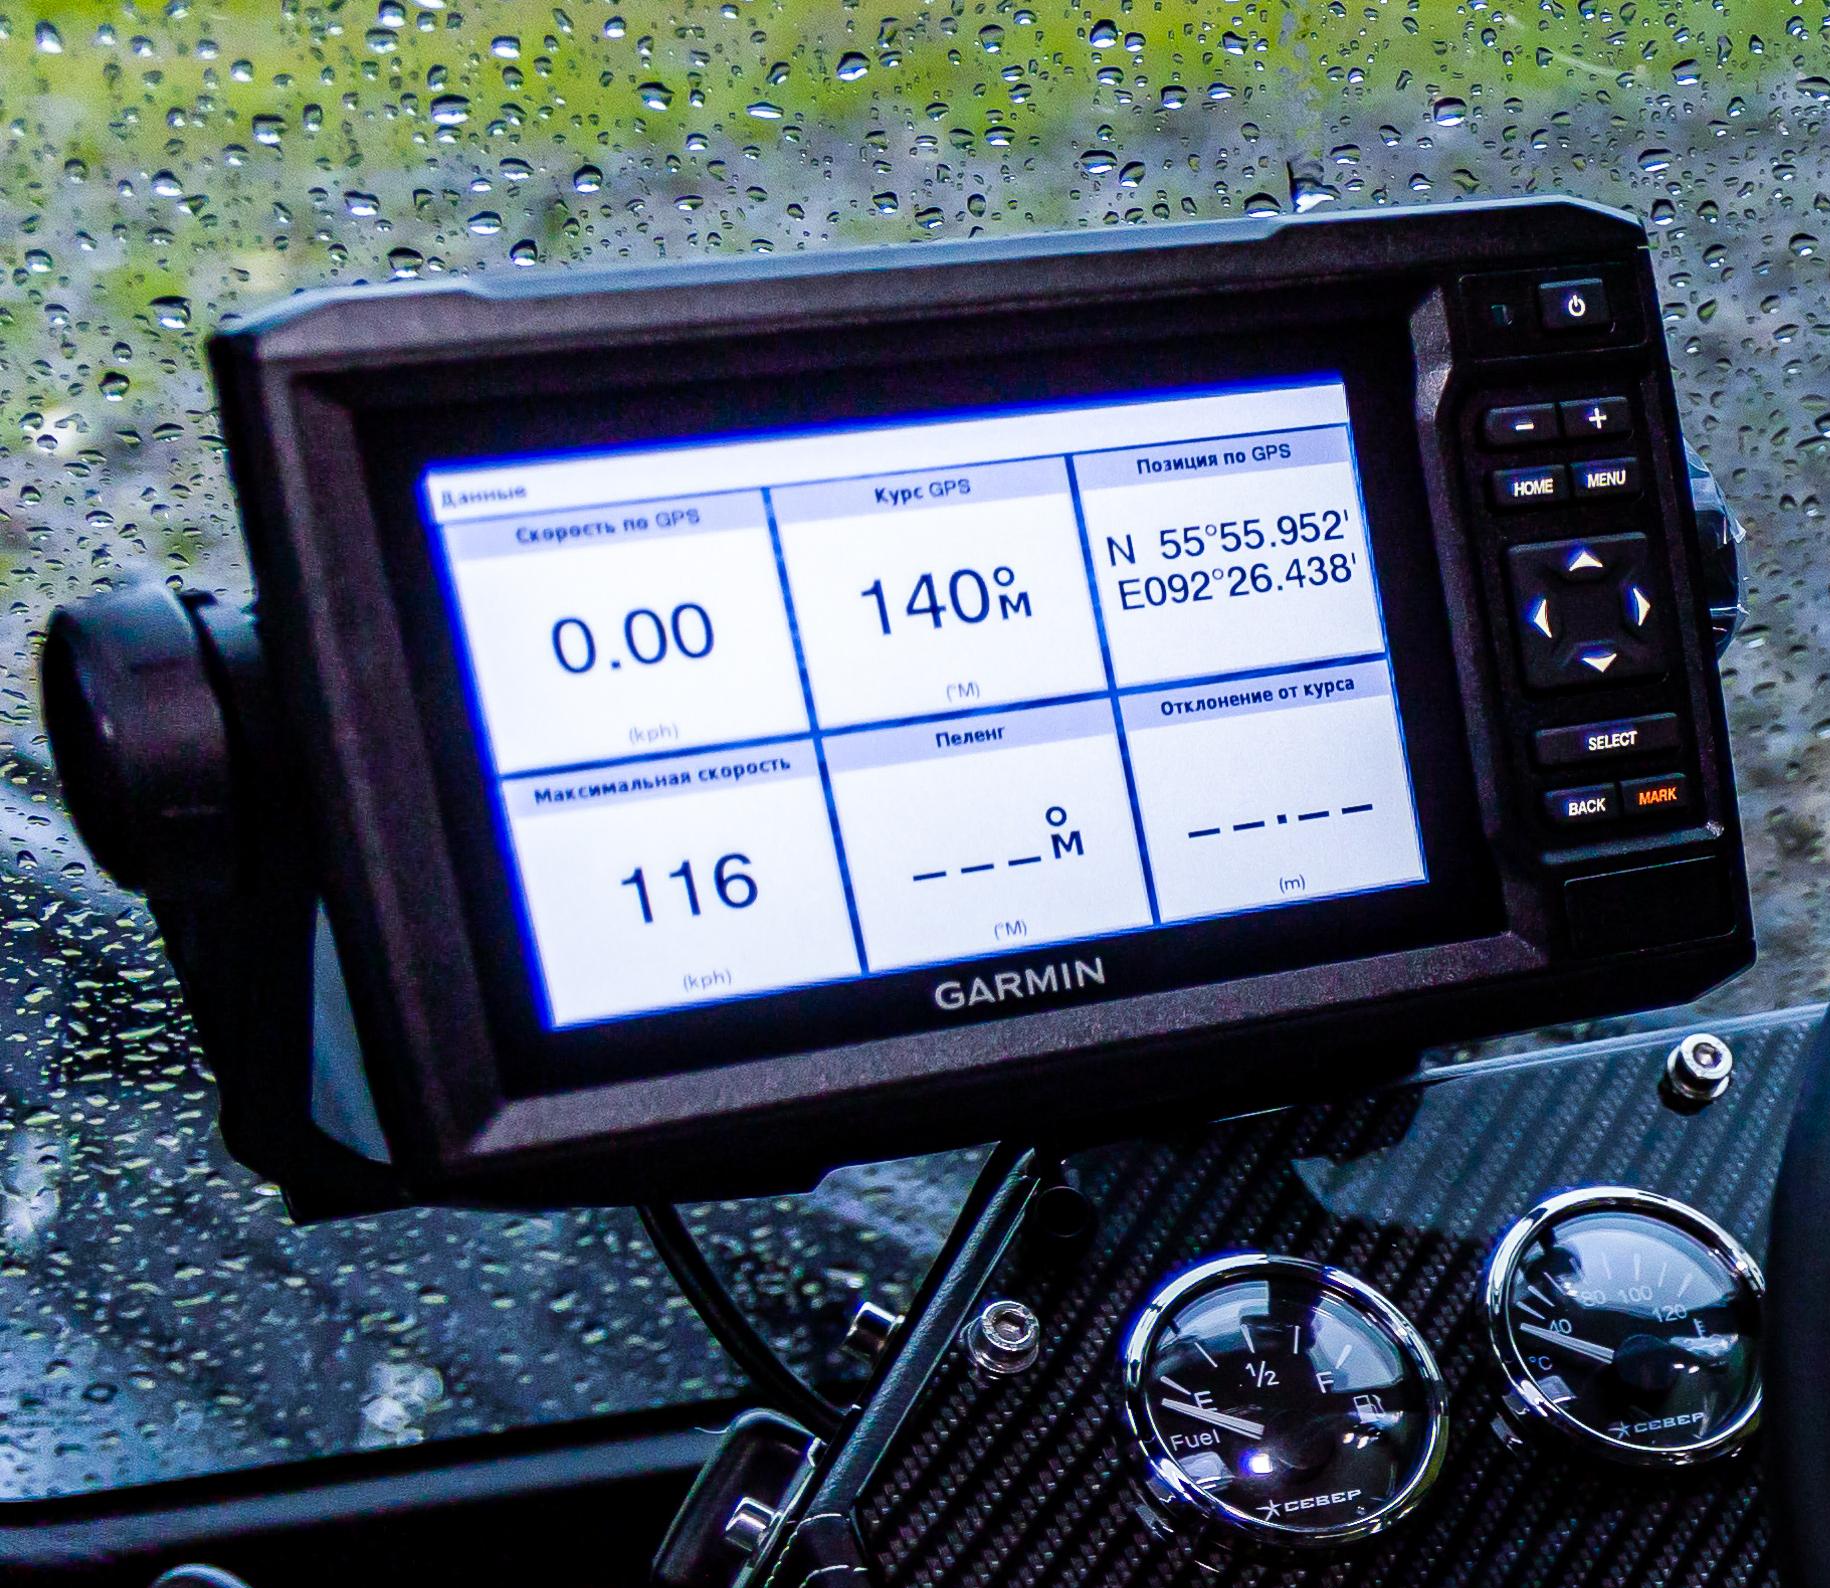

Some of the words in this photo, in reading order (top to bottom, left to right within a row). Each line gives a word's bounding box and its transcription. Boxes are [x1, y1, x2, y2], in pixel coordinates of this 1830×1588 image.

[1136, 452, 1218, 476] Позиция
[1223, 448, 1247, 467] по
[1250, 443, 1291, 463] GPS
[1513, 477, 1555, 497] HOME
[1586, 469, 1628, 488] MENU
[441, 485, 527, 509] Данные
[874, 484, 924, 505] Курс
[928, 478, 971, 498] GPS
[516, 520, 615, 544] Скорость
[623, 517, 648, 531] по
[656, 508, 700, 528] GPS
[1107, 534, 1136, 567] N
[551, 602, 715, 675] 0.00
[1160, 688, 1273, 717] Отклонение
[1277, 683, 1300, 701] от
[1303, 676, 1356, 701] курса
[935, 723, 1004, 749] Пеленг
[1587, 730, 1638, 751] SELECT
[533, 769, 692, 806] Максимальная
[697, 755, 791, 784] скорость
[1568, 796, 1607, 817] BACK
[1638, 785, 1679, 806] MARK
[620, 851, 760, 925] 116
[1279, 873, 1306, 895] (m)
[683, 968, 733, 992] (kph)
[934, 957, 1107, 1012] GARMIN
[1616, 1285, 1653, 1305] 100
[1652, 1303, 1688, 1323] 120
[1633, 1410, 1706, 1435] СЕВЕР
[1171, 1428, 1221, 1452] Fuel
[1284, 1489, 1362, 1514] СЕВЕР
